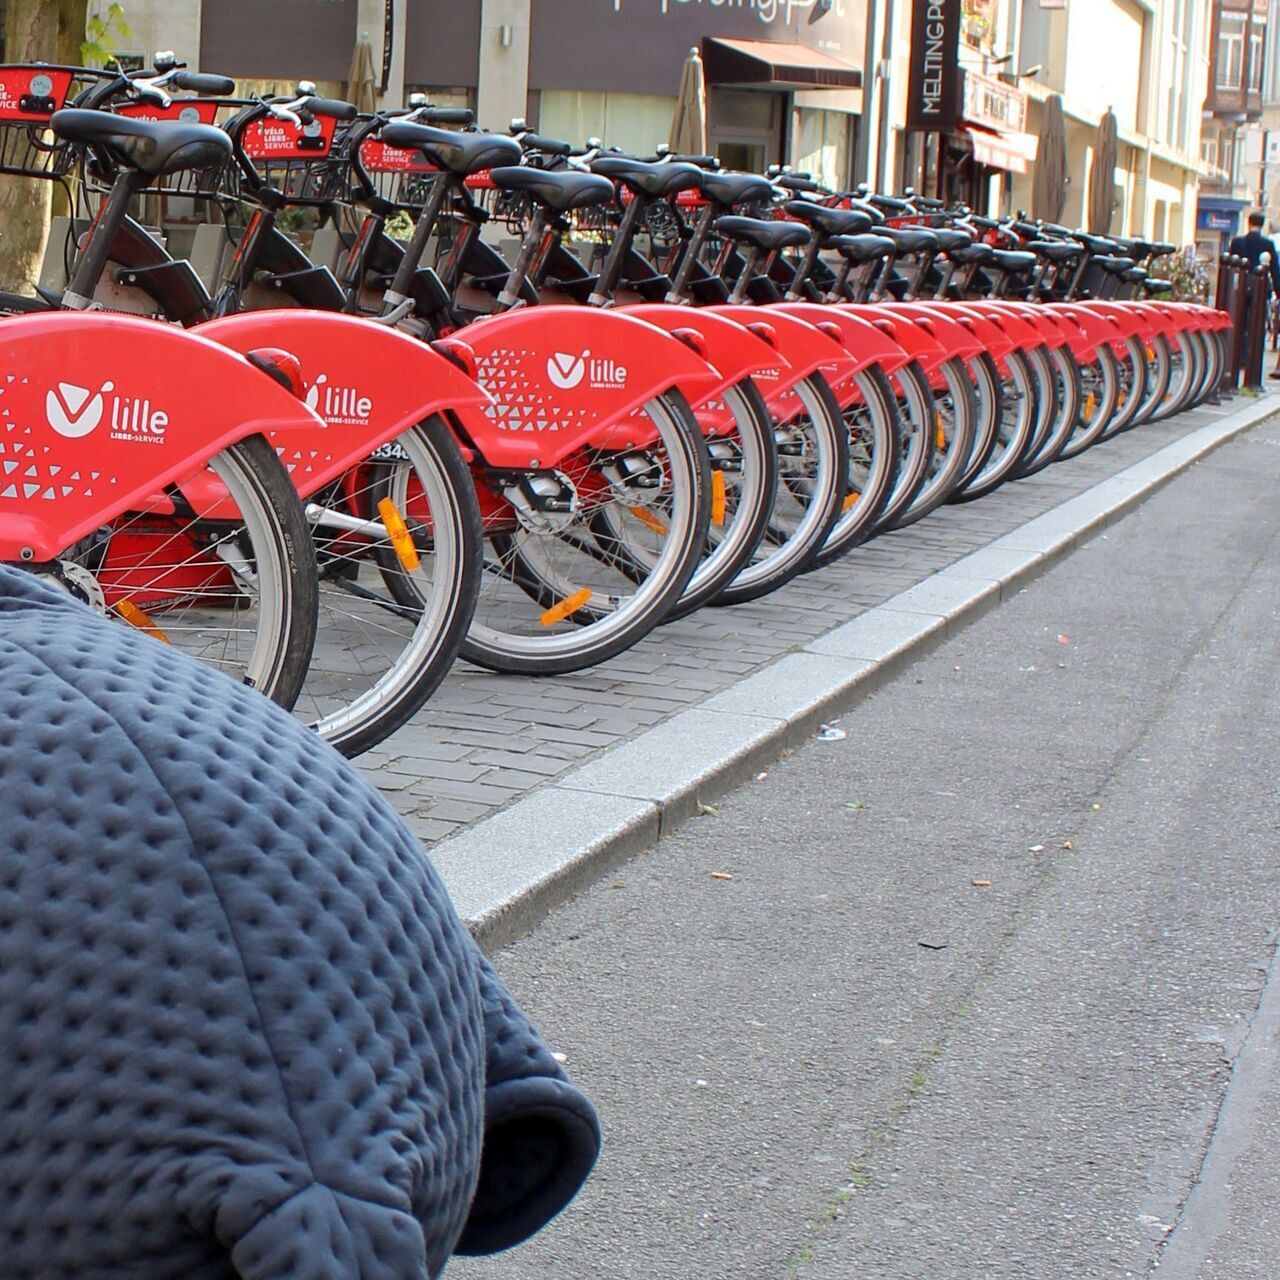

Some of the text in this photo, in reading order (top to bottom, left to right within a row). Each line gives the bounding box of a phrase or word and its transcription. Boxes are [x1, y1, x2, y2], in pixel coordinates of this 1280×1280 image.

[922, 22, 945, 114] MELTING
[264, 126, 285, 135] VÉLO
[590, 359, 627, 383] lille
[111, 396, 169, 434] lille
[325, 387, 372, 417] lille
[110, 431, 165, 444] LIBRE-SERVICE
